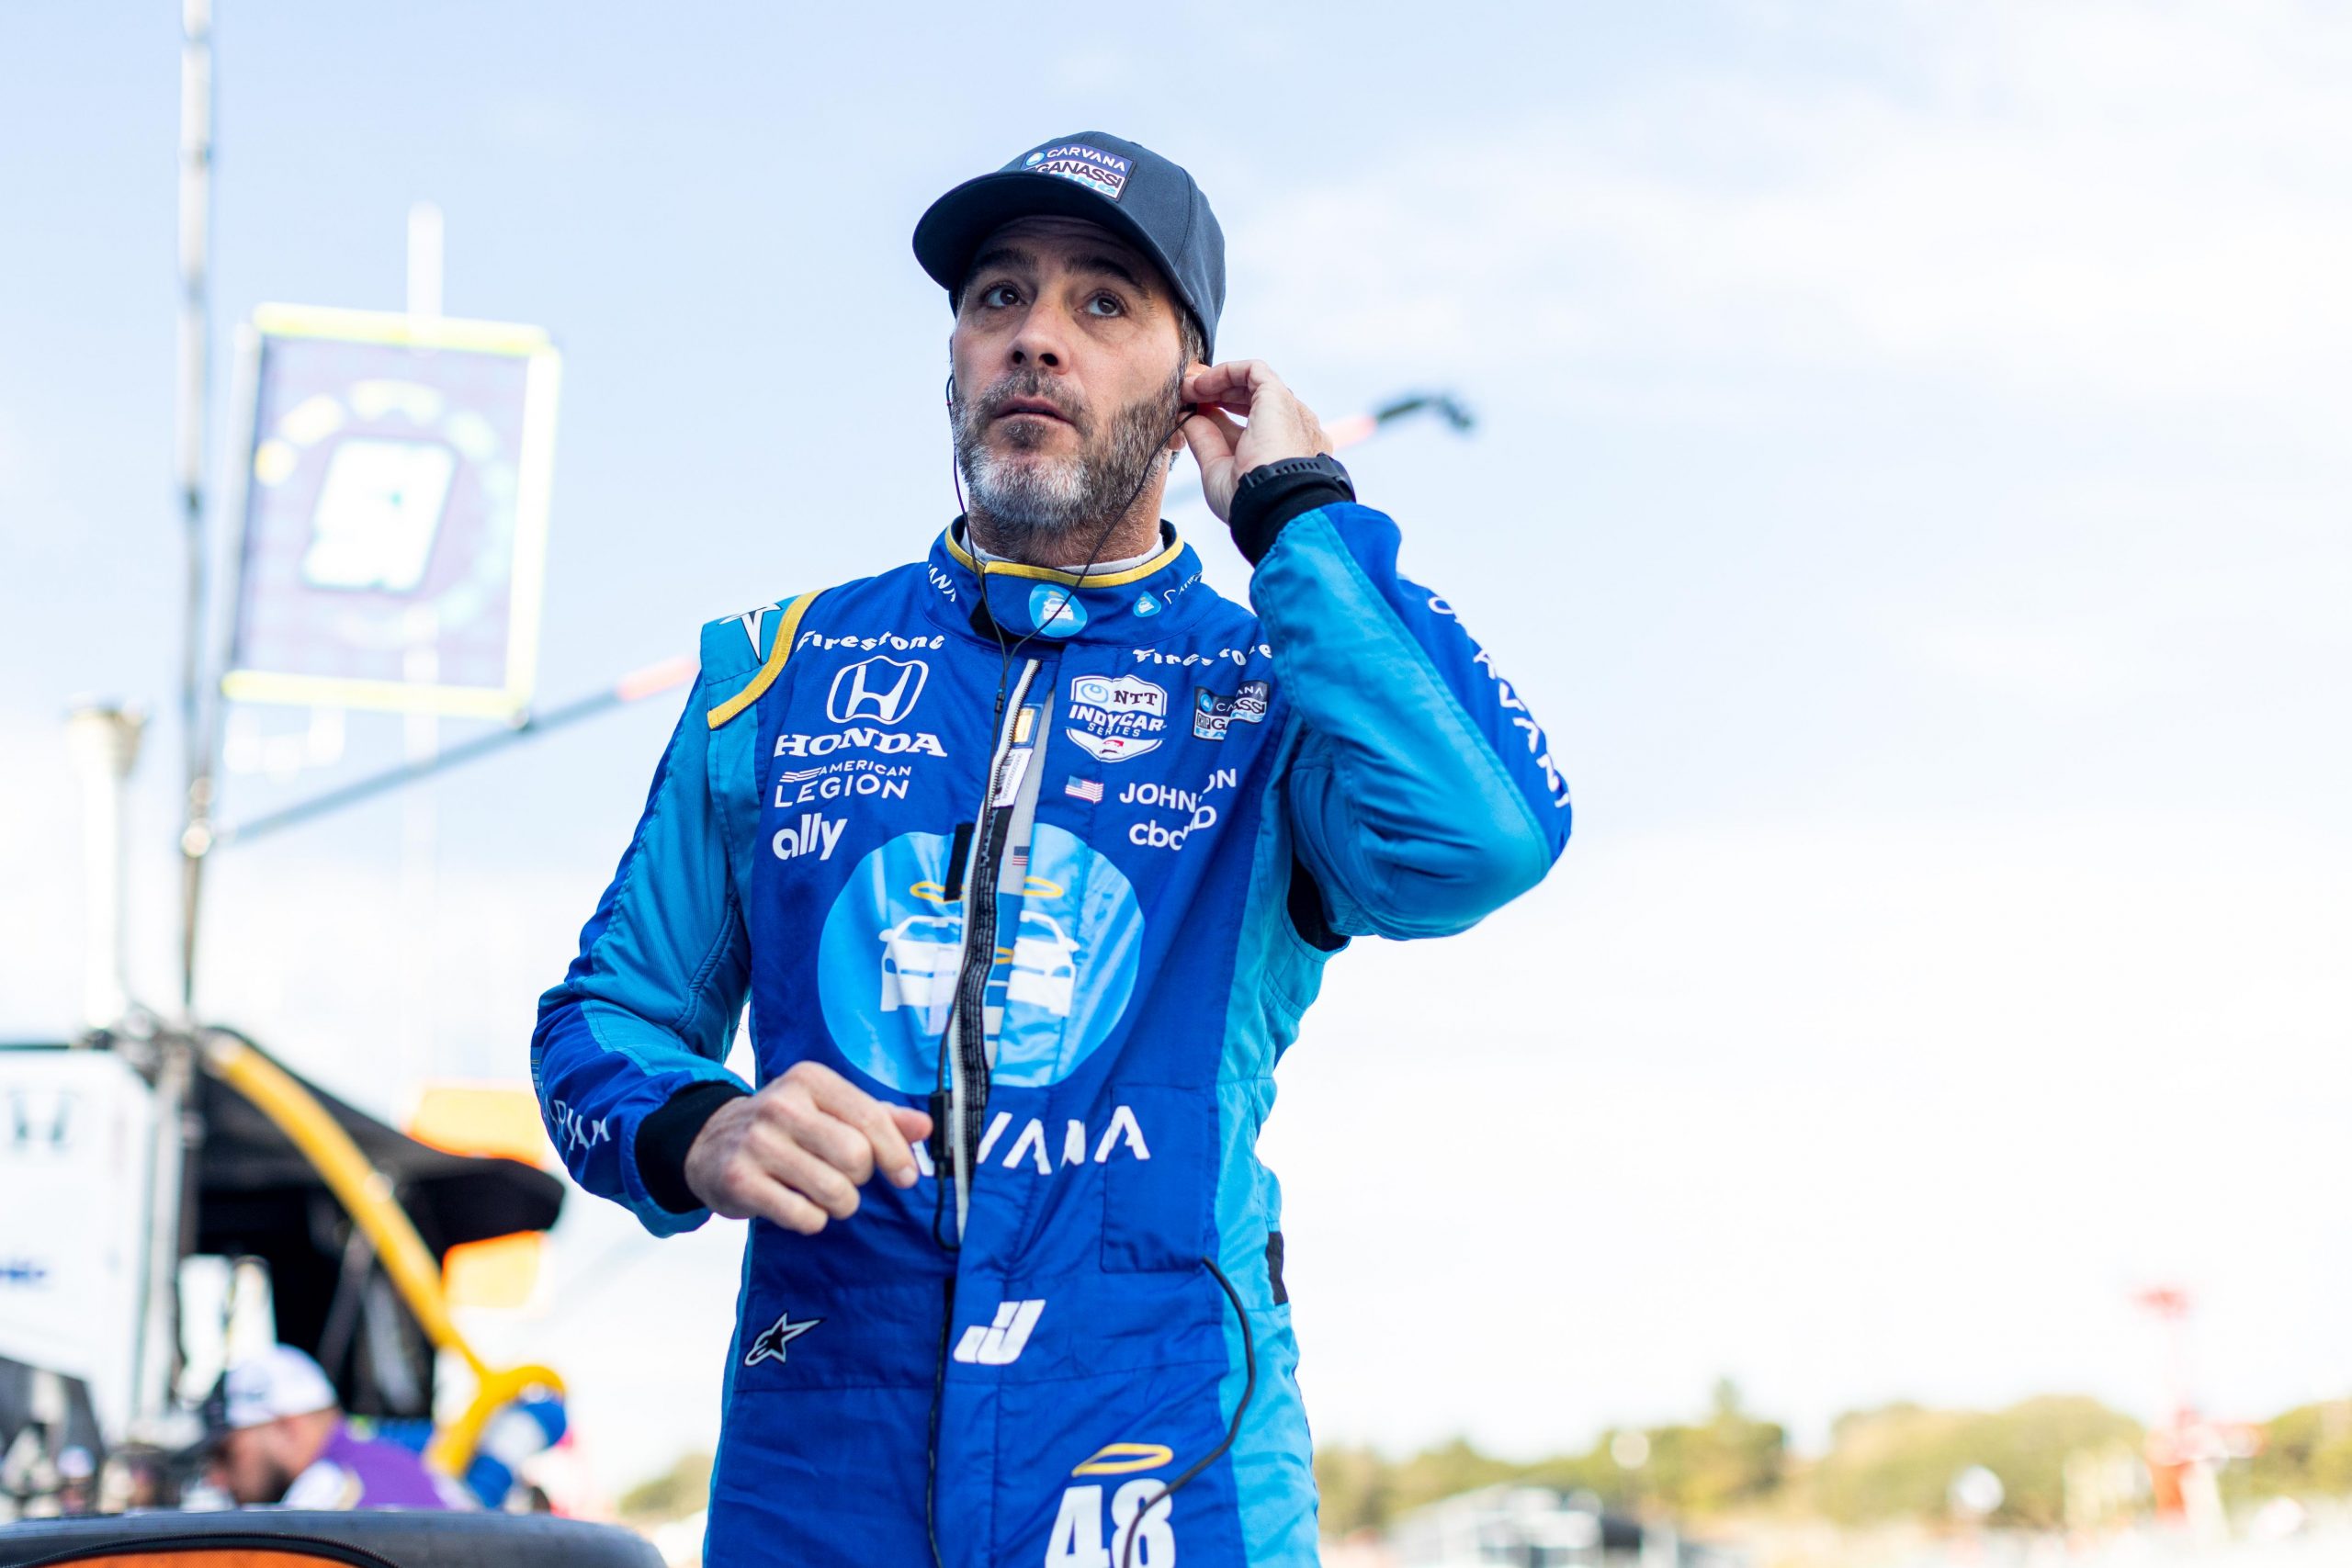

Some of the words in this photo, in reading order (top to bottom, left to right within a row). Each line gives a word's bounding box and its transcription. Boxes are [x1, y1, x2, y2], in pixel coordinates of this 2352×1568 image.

[1046, 147, 1125, 172] CARVANA
[796, 630, 945, 652] Firestone
[1114, 690, 1158, 705] NTT
[1069, 705, 1164, 731] INDYCAR
[1087, 722, 1141, 738] SERIES
[774, 727, 948, 757] HONDA
[818, 760, 912, 777] AMERICAN
[774, 773, 910, 807] LEGION
[772, 812, 848, 861] ally
[1045, 1478, 1176, 1568] 48
